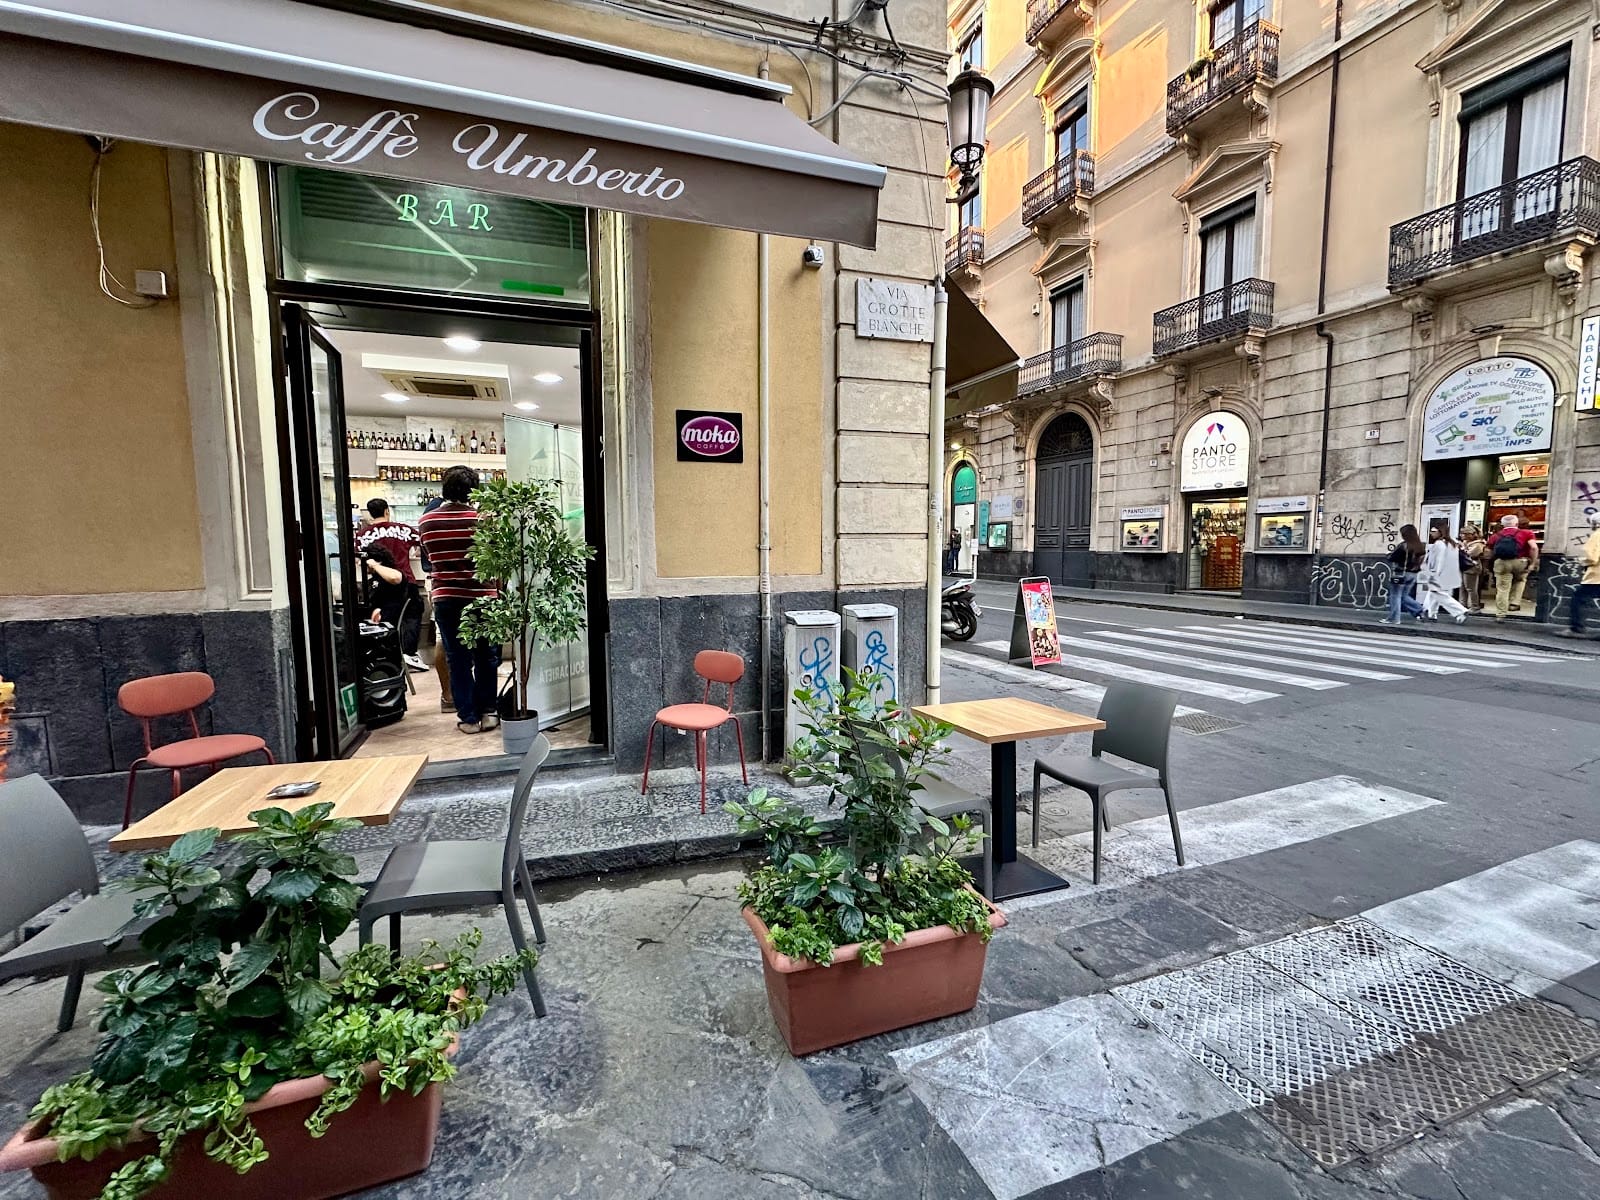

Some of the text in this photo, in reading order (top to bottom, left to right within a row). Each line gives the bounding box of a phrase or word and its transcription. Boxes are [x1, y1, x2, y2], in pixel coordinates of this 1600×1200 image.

[252, 92, 686, 200] Caffè Umberto
[396, 194, 494, 231] BAR
[887, 287, 908, 300] VIA
[868, 302, 926, 319] GROTTE
[869, 318, 925, 336] BIANCHE
[1581, 323, 1595, 405] TABACCHI
[1463, 383, 1488, 391] CANONE
[1429, 391, 1480, 420] LOTTOMATICARD
[1433, 391, 1472, 413] CARTOLERIA
[1471, 416, 1498, 427] SKY
[684, 425, 737, 443] moka
[1505, 438, 1532, 446] INPS
[1193, 443, 1237, 458] PANTO
[1192, 455, 1236, 469] STORE
